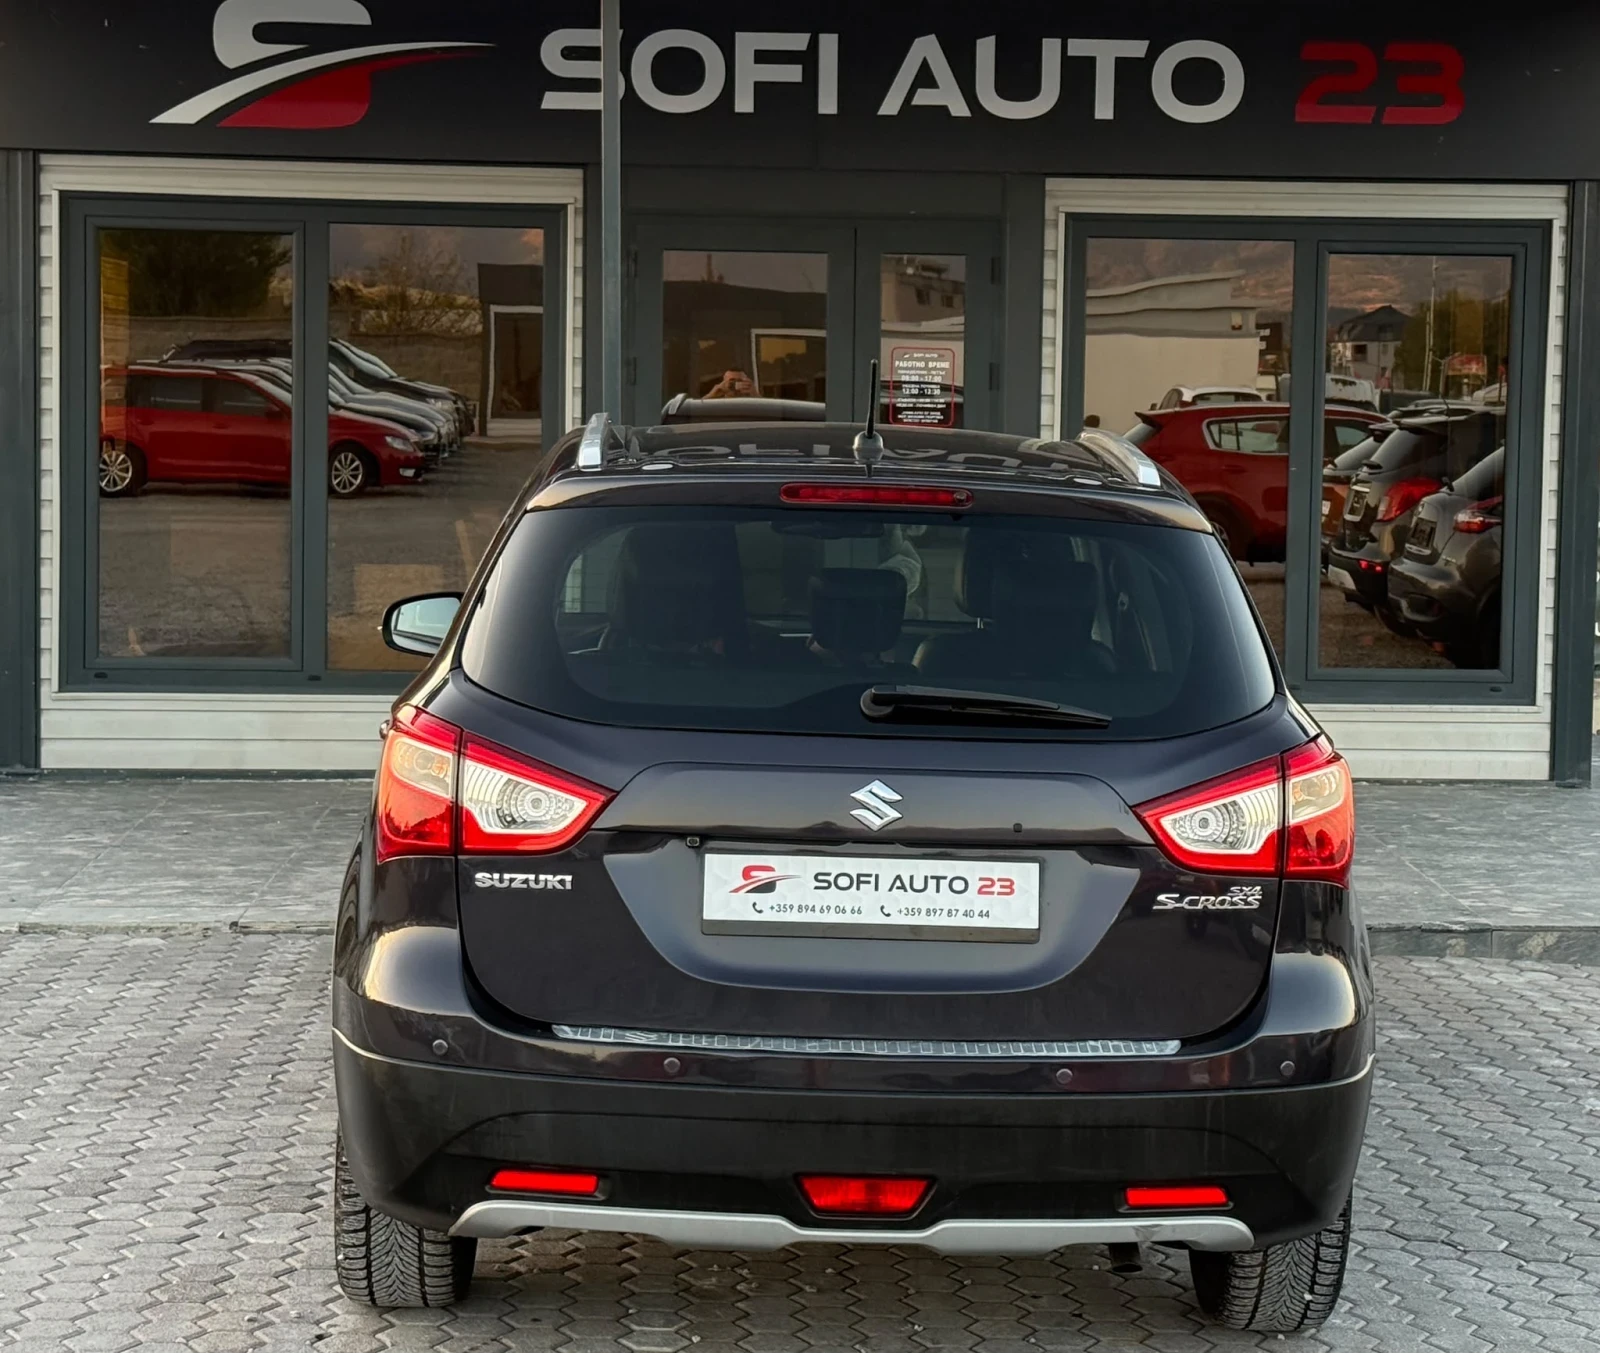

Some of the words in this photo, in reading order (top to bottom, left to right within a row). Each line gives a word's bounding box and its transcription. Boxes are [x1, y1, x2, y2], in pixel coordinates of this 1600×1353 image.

[540, 28, 838, 114] SOFI
[877, 33, 1245, 124] AUTO
[1295, 41, 1466, 125] 23
[928, 361, 950, 369] ВРЕМЕ
[474, 872, 573, 890] SUZUKI
[813, 872, 879, 892] SOFI
[888, 875, 969, 895] AUTO
[977, 877, 1016, 896] 23
[1227, 886, 1263, 896] SX4
[1152, 893, 1262, 910] S-CROSS
[769, 903, 795, 913] +359
[797, 904, 816, 914] 894
[819, 904, 832, 914] 69
[834, 905, 847, 915] 06
[850, 905, 863, 915] 66
[896, 907, 922, 916] +359
[925, 908, 944, 917] 897
[946, 908, 959, 918] 87
[962, 909, 975, 919] 40
[977, 909, 990, 919] 44
